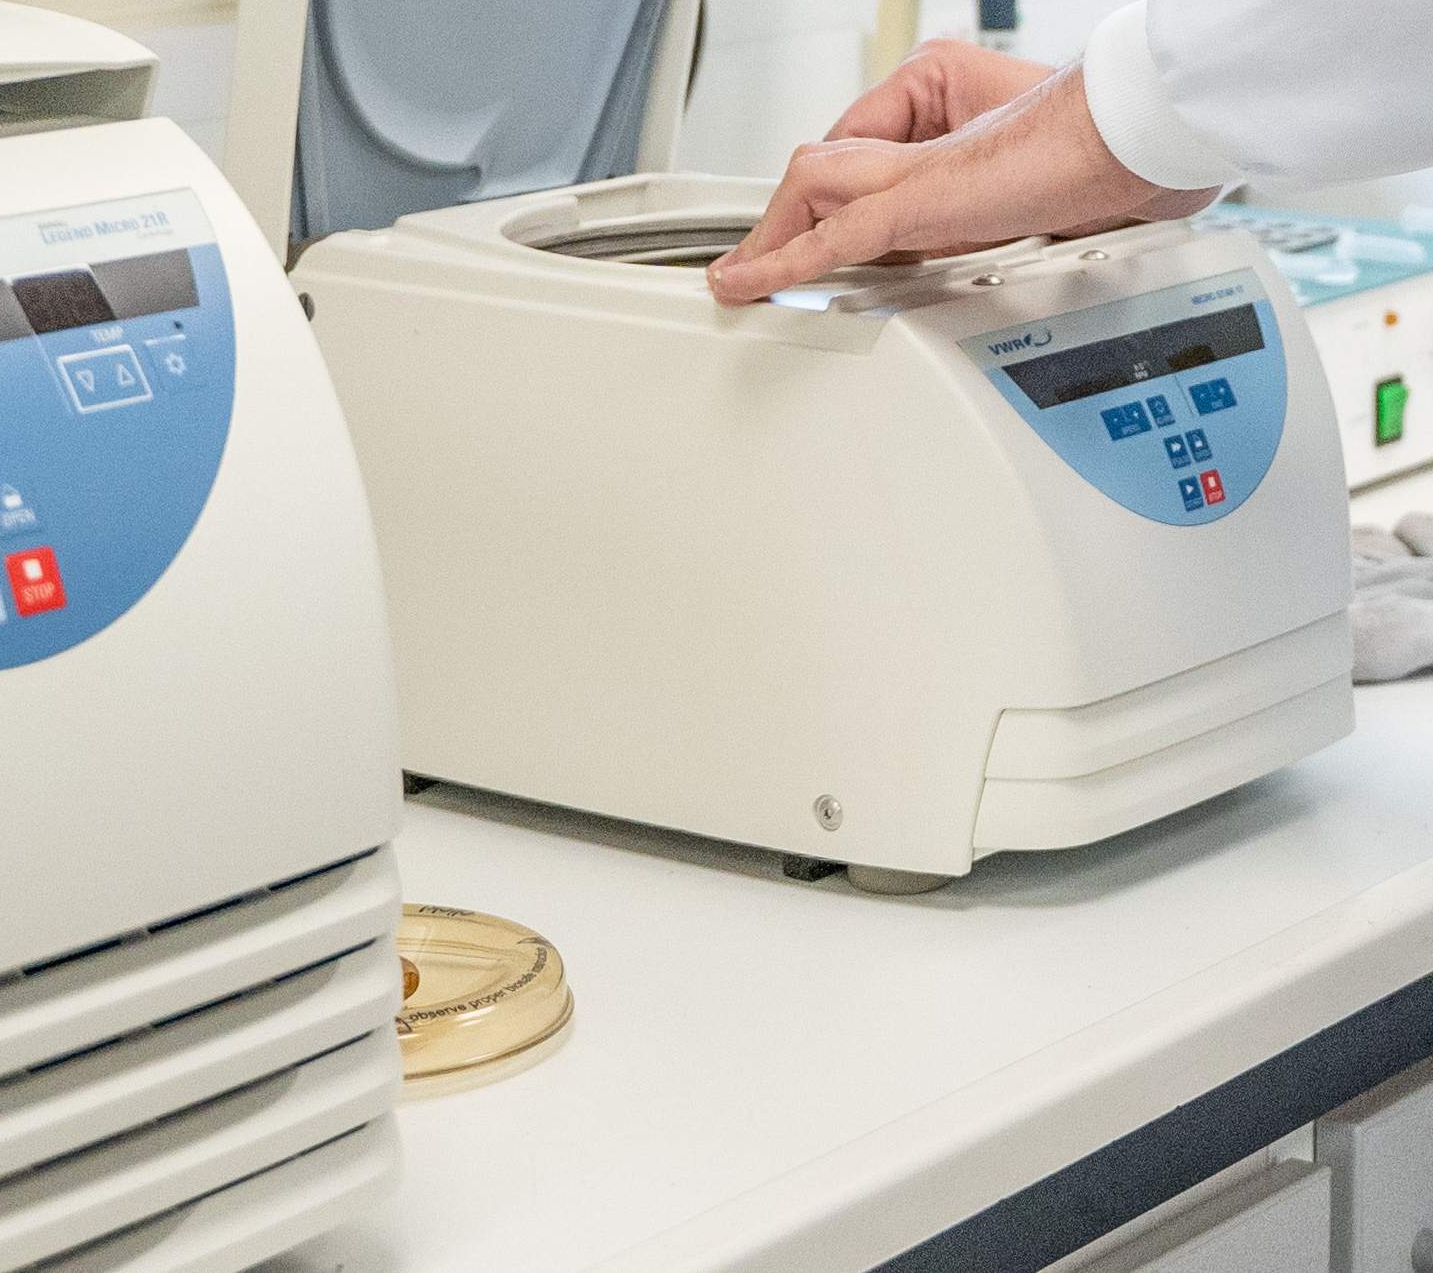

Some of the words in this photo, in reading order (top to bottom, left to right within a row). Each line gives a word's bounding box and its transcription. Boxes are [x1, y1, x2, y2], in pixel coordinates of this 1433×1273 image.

[988, 339, 1024, 356] VWR
[409, 1003, 467, 1022] observe
[468, 989, 505, 1009] proper
